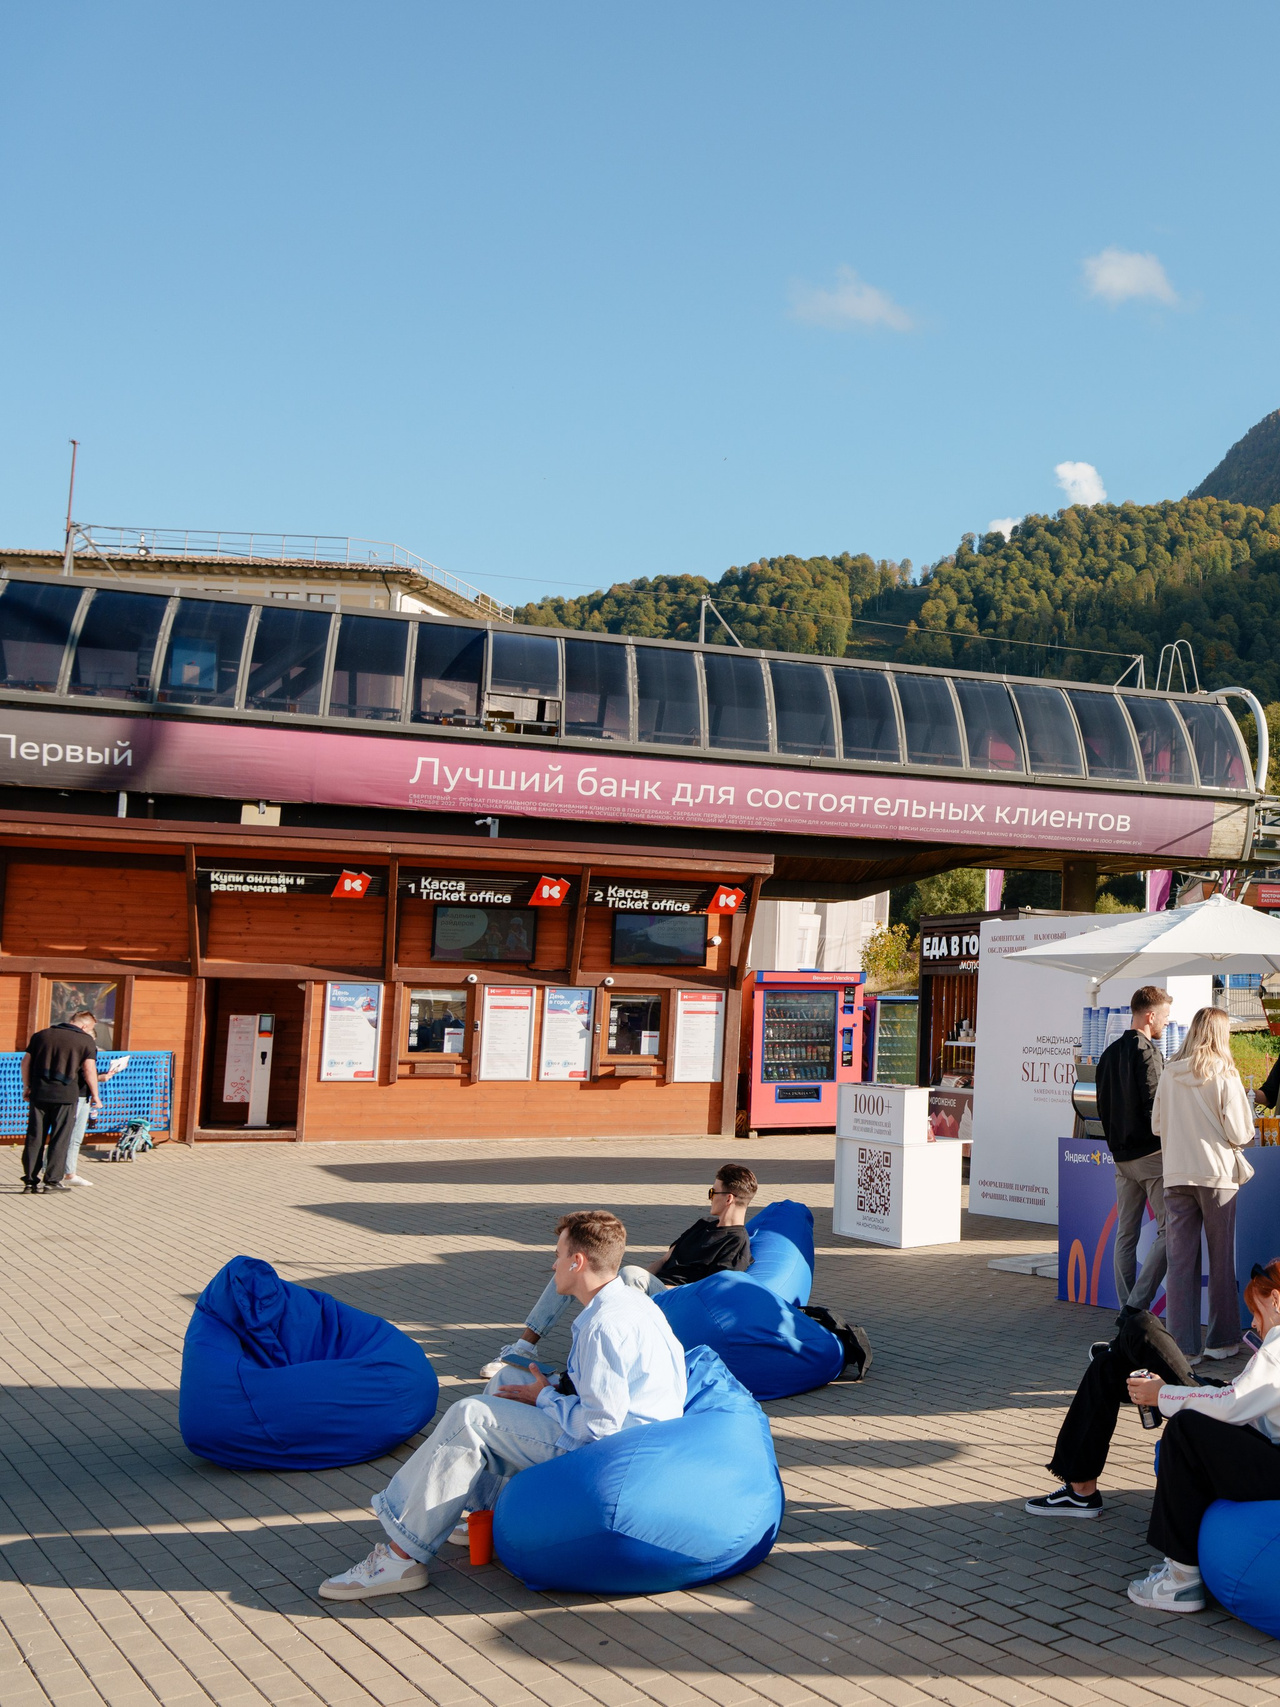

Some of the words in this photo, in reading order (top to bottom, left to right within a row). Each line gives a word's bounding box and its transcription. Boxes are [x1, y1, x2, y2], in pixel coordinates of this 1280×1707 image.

[409, 756, 564, 794] Лучший
[577, 767, 662, 800] банк
[671, 782, 735, 807] для
[746, 787, 986, 823] состоятельных
[995, 805, 1131, 833] клиентов
[409, 793, 451, 801] СБЕРПЕРВЫЙ
[459, 796, 486, 804] ФОРМАТ
[486, 798, 537, 807] ПРЕМИАЛЬНОГО
[538, 801, 589, 810] ОБСЛУЖИВАНИЯ
[673, 810, 702, 818] СБЕРБАНК
[459, 802, 502, 810] ГЕНЕРАЛЬНАЯ
[503, 804, 536, 812] ЛИЦЕНЗИЯ
[595, 811, 645, 819] ОСУЩЕСТВЛЕНИЕ
[686, 816, 716, 824] ОПЕРАЦИЙ
[210, 872, 244, 883] Купи
[246, 874, 296, 885] онлайн
[296, 876, 305, 885] и
[408, 883, 415, 893] 1
[420, 877, 466, 891] Касса
[210, 883, 287, 894] распечатай
[593, 890, 604, 902] 2
[607, 885, 649, 899] Касса
[420, 889, 466, 902] Ticket
[470, 890, 512, 904] office
[606, 897, 649, 910] Ticket
[652, 899, 691, 912] office
[923, 936, 948, 960] ЕДА
[951, 935, 960, 956] В
[962, 934, 979, 956] ГО
[1022, 1046, 1071, 1056] ЮРИДИЧЕСКАЯ
[1021, 1061, 1050, 1083] SLT
[1053, 1062, 1077, 1085] GR
[853, 1093, 892, 1117] 1000+
[1064, 1150, 1090, 1164] Яндекс
[1102, 1154, 1116, 1164] Рек
[862, 1215, 885, 1224] ЗАПИСАТЬСЯ
[863, 1222, 890, 1233] КОНСУЛЬТАЦИЮ
